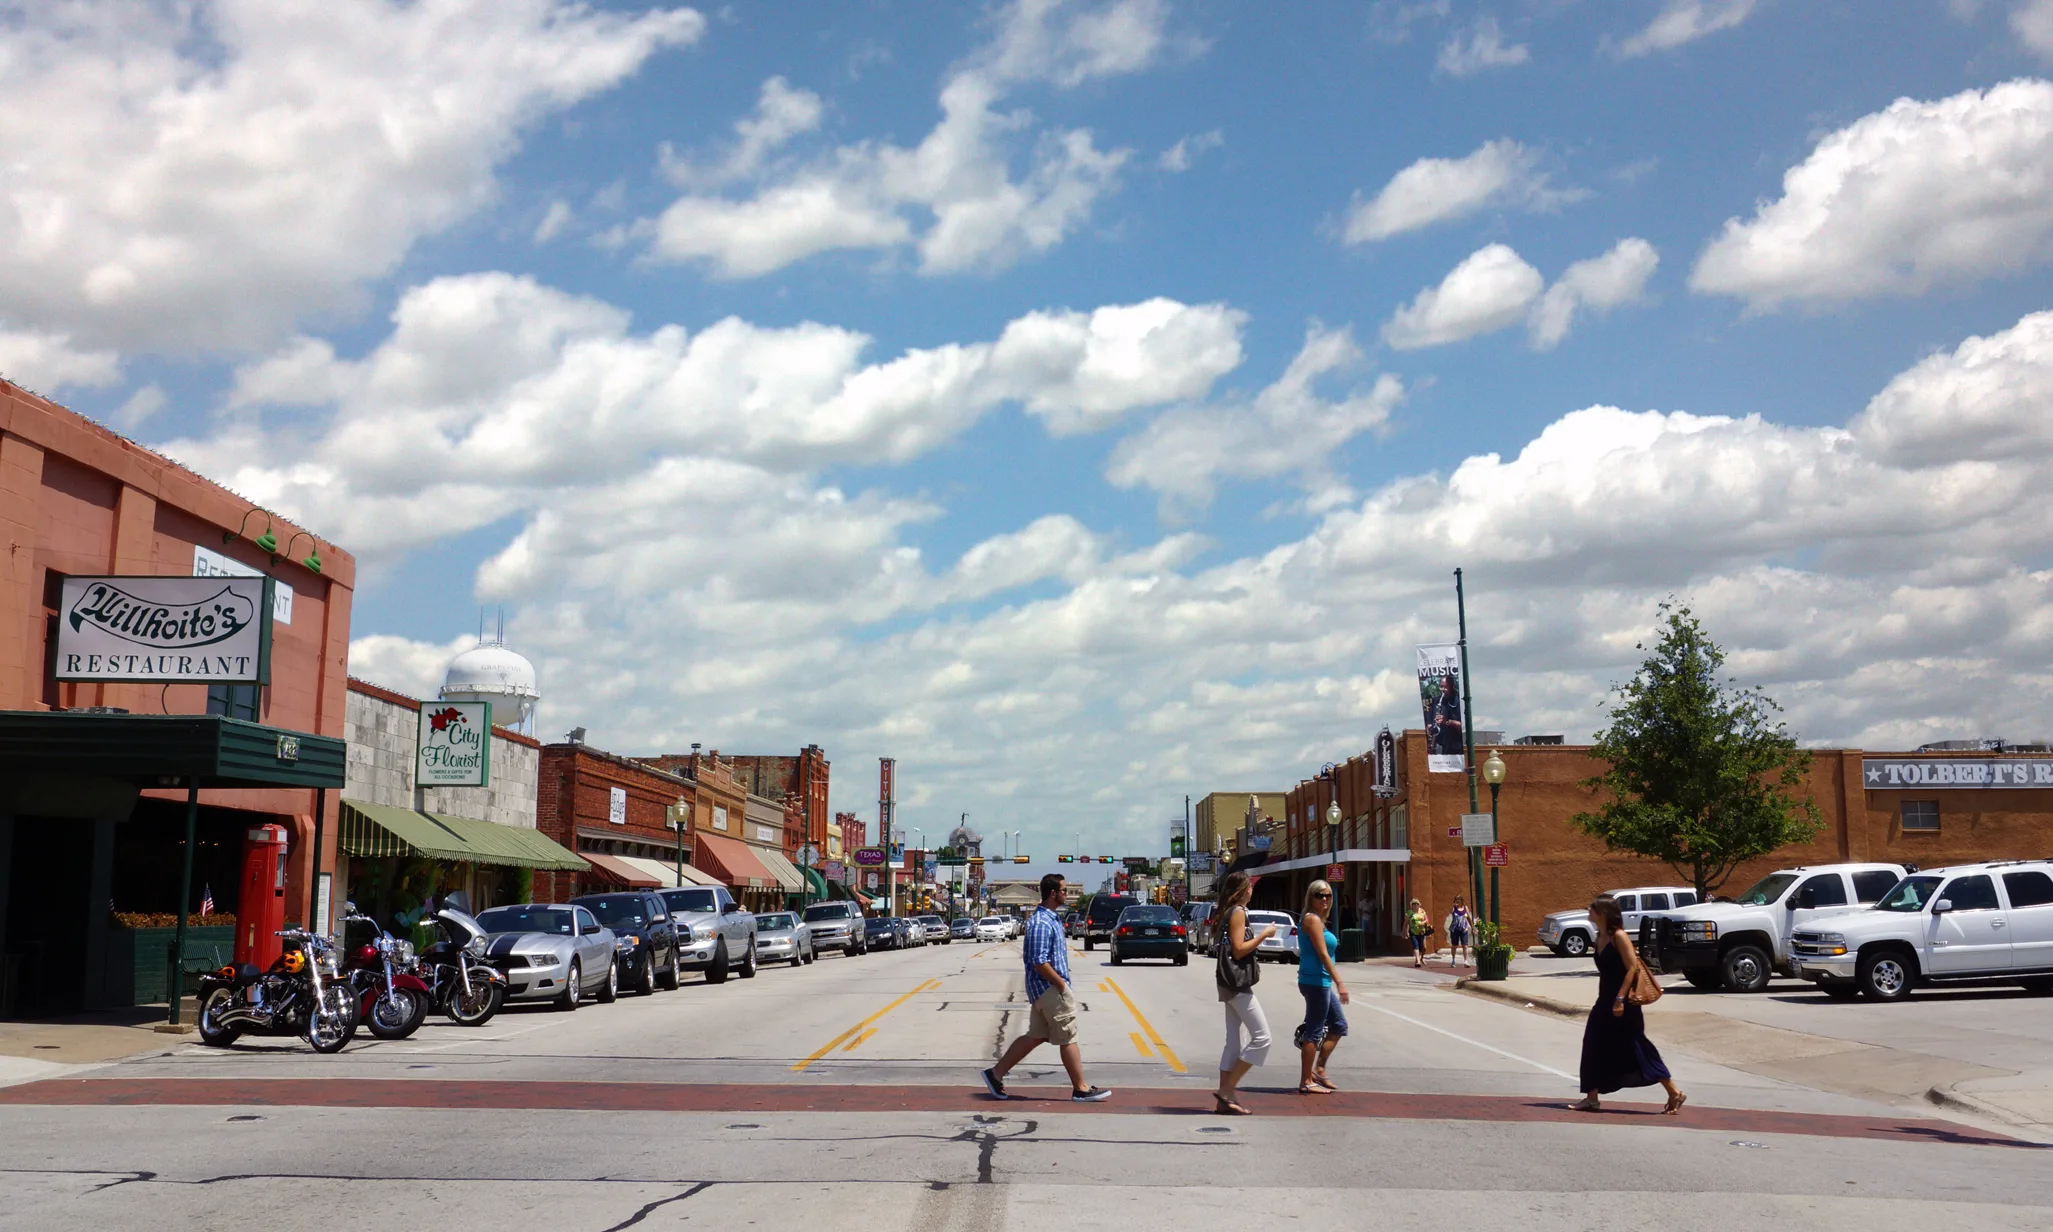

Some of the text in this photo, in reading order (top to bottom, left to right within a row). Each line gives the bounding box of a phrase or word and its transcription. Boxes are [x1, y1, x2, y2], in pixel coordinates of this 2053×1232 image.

[66, 654, 250, 675] RESTAURANT
[1418, 657, 1457, 667] CELEBRATE
[1419, 666, 1459, 677] MUSIC
[449, 723, 480, 750] City
[421, 745, 481, 768] Florist
[1885, 764, 2028, 784] TOLBERT'S
[859, 850, 881, 858] TEXAS
